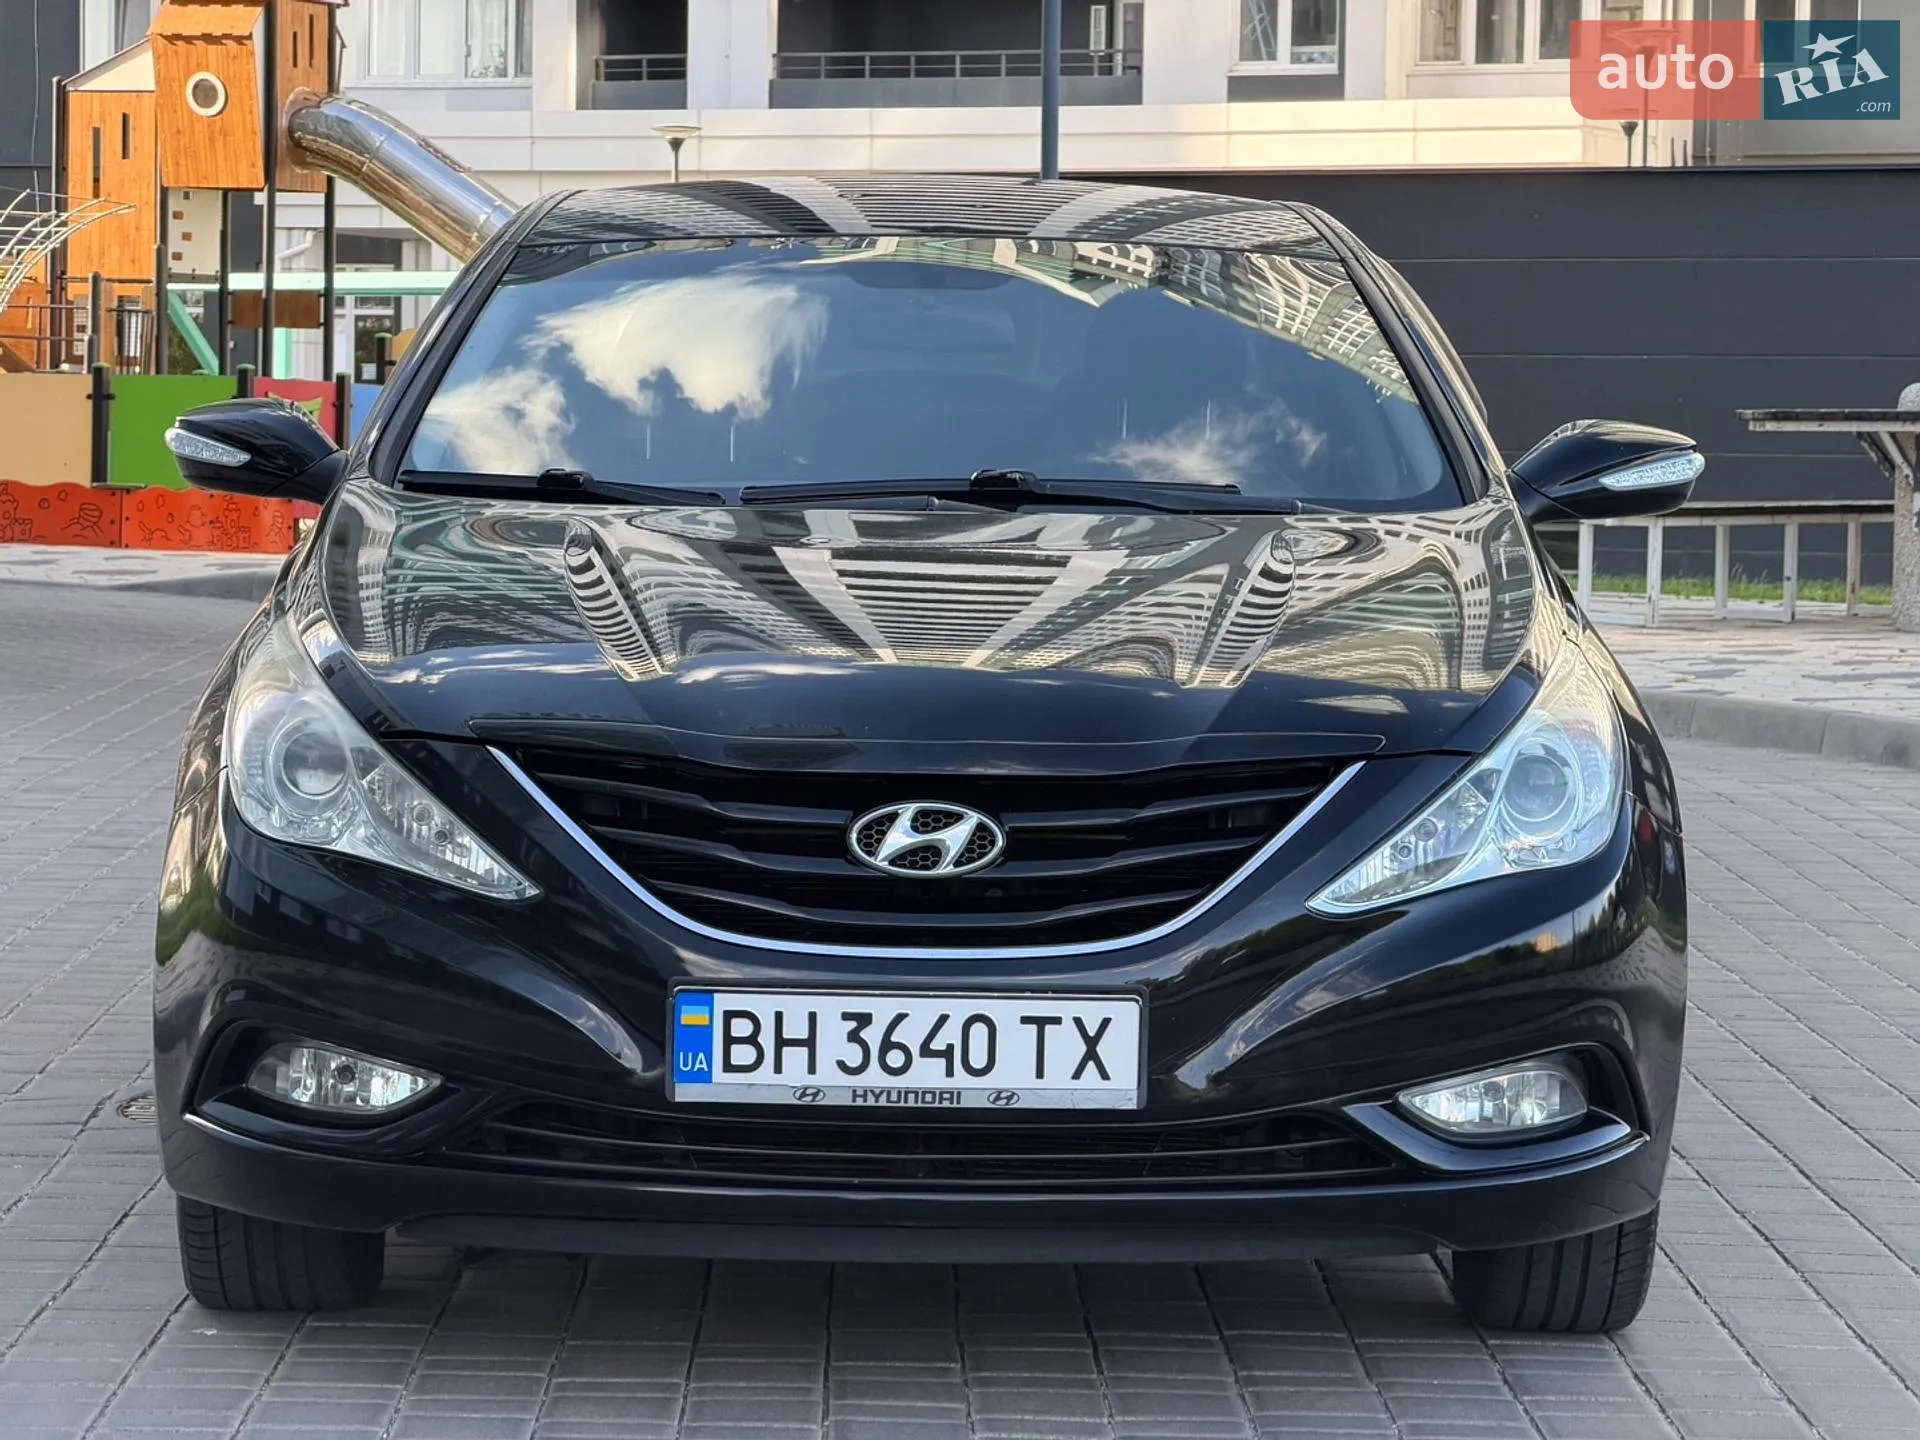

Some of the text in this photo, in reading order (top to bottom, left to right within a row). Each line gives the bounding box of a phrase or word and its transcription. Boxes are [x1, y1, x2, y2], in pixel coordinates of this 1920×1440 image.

[722, 1009, 1112, 1081] BH 3640 TX
[679, 1052, 708, 1072] UA
[851, 1089, 961, 1106] HYUNDAI
